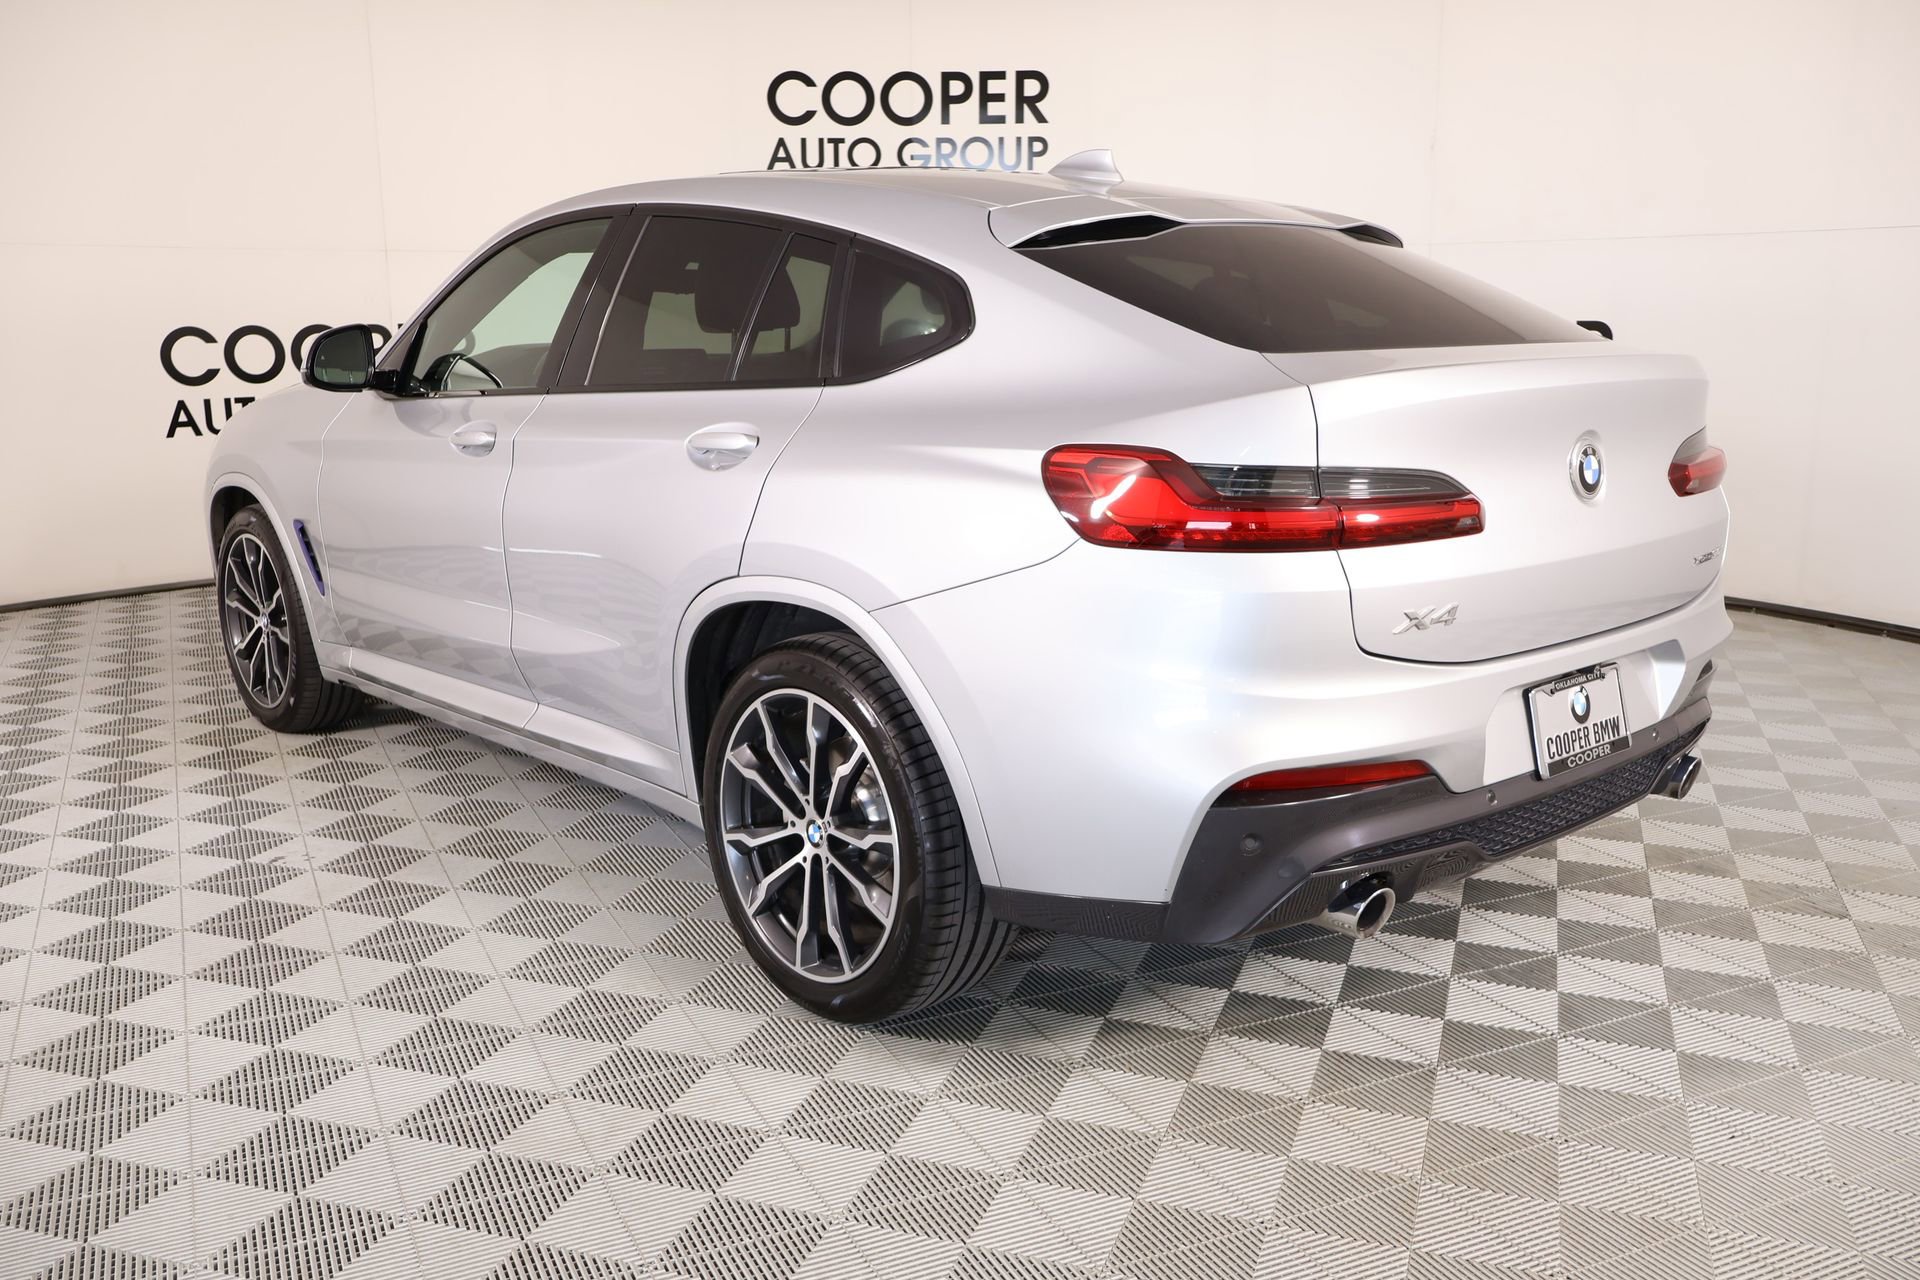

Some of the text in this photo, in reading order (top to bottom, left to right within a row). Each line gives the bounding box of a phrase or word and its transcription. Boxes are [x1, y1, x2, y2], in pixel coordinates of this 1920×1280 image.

[767, 70, 1049, 126] COOPER
[767, 136, 1049, 172] AUTO GROUP
[1392, 601, 1459, 635] X4
[1555, 675, 1587, 690] OKLAHOMA
[1546, 716, 1620, 760] COOPER BMW
[1567, 744, 1611, 768] COOPER
